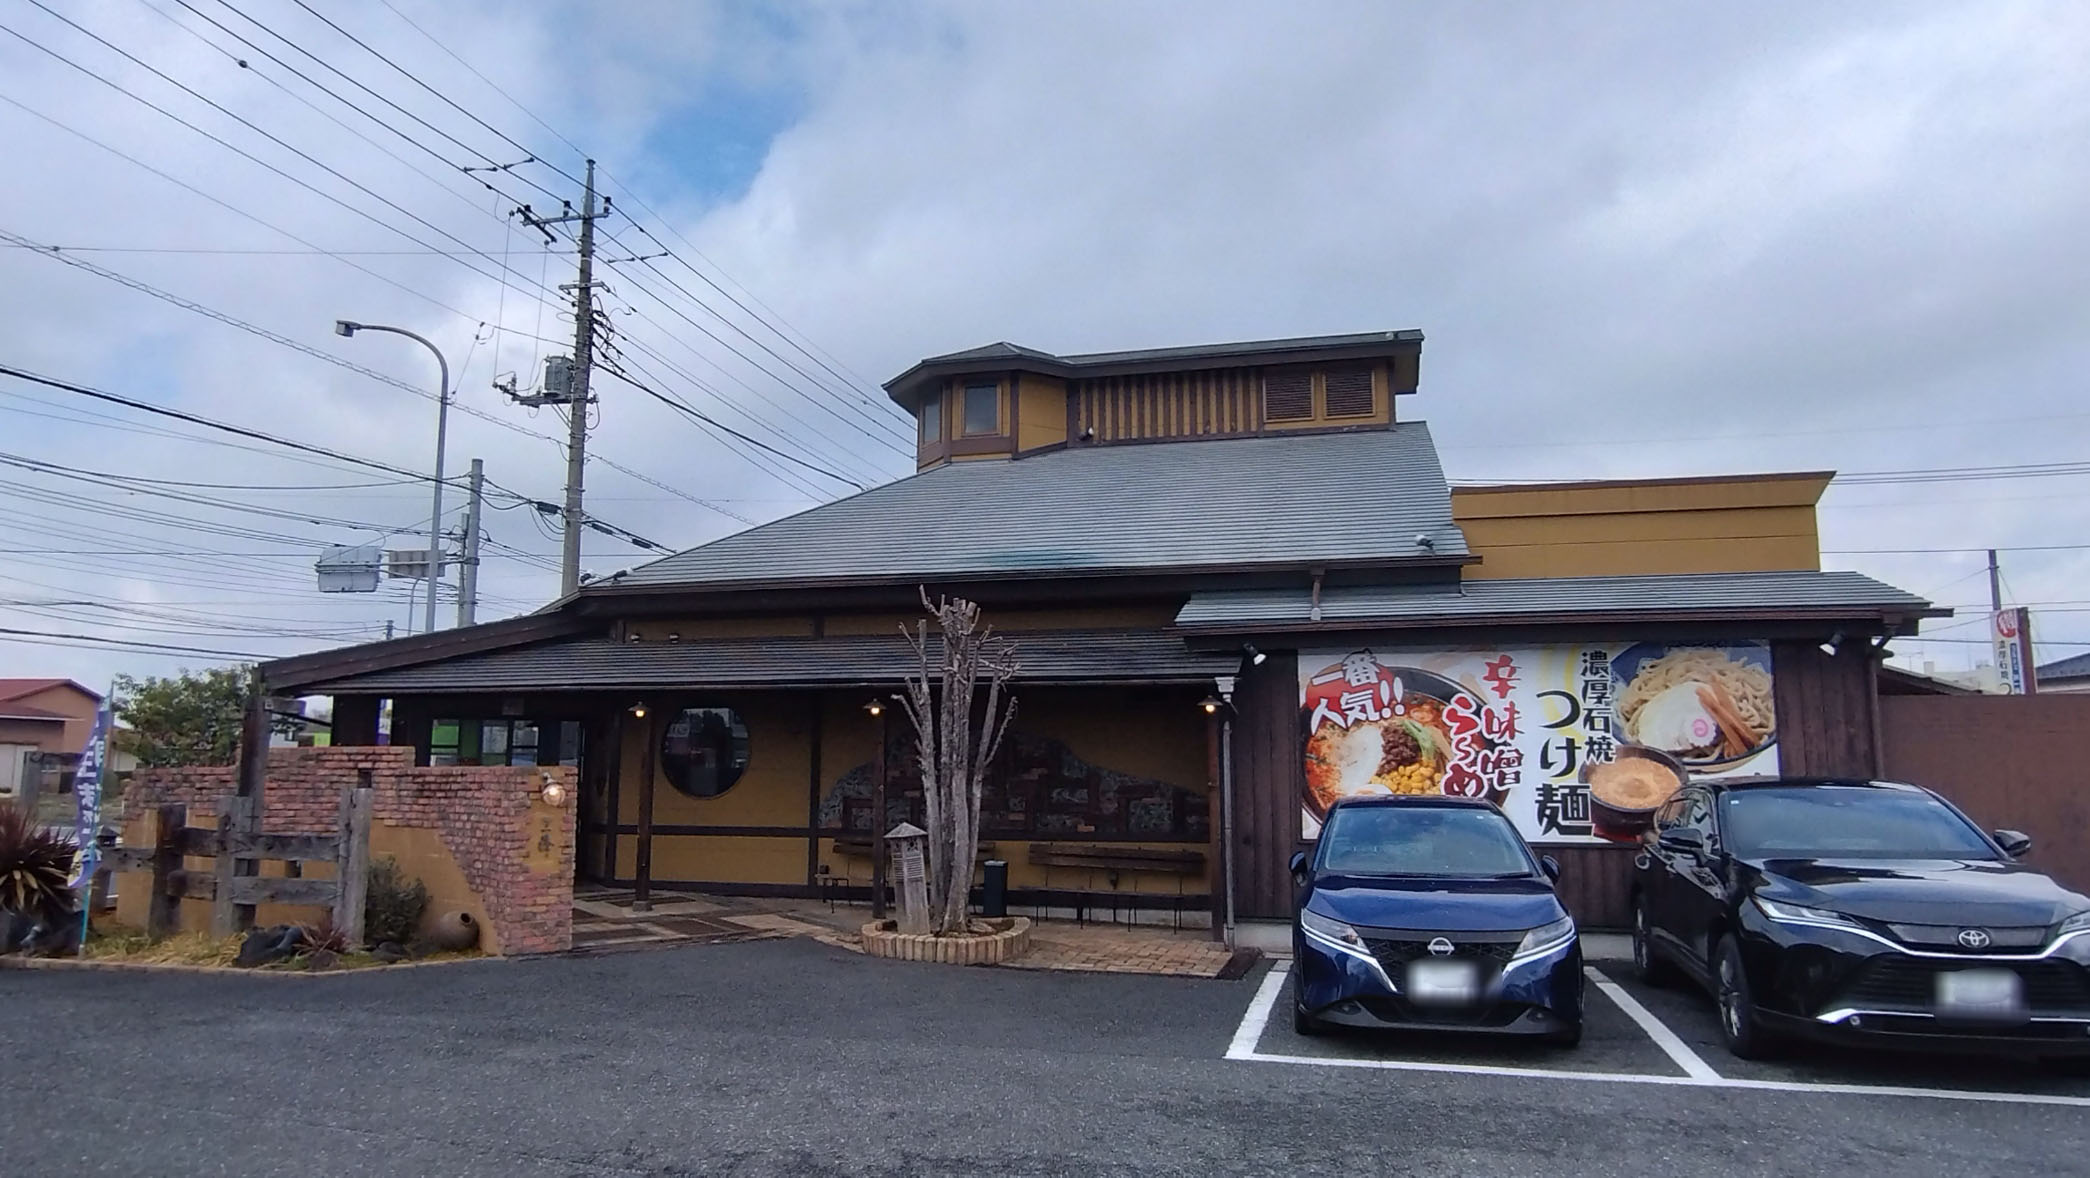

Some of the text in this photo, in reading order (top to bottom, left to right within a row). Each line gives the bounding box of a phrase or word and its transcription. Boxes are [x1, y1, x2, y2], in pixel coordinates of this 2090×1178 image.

[1311, 653, 1379, 687] 一番
[1481, 654, 1524, 788] 辛味噌
[1581, 650, 1616, 763] 濃厚石焼
[1535, 690, 1593, 836] つけ麺
